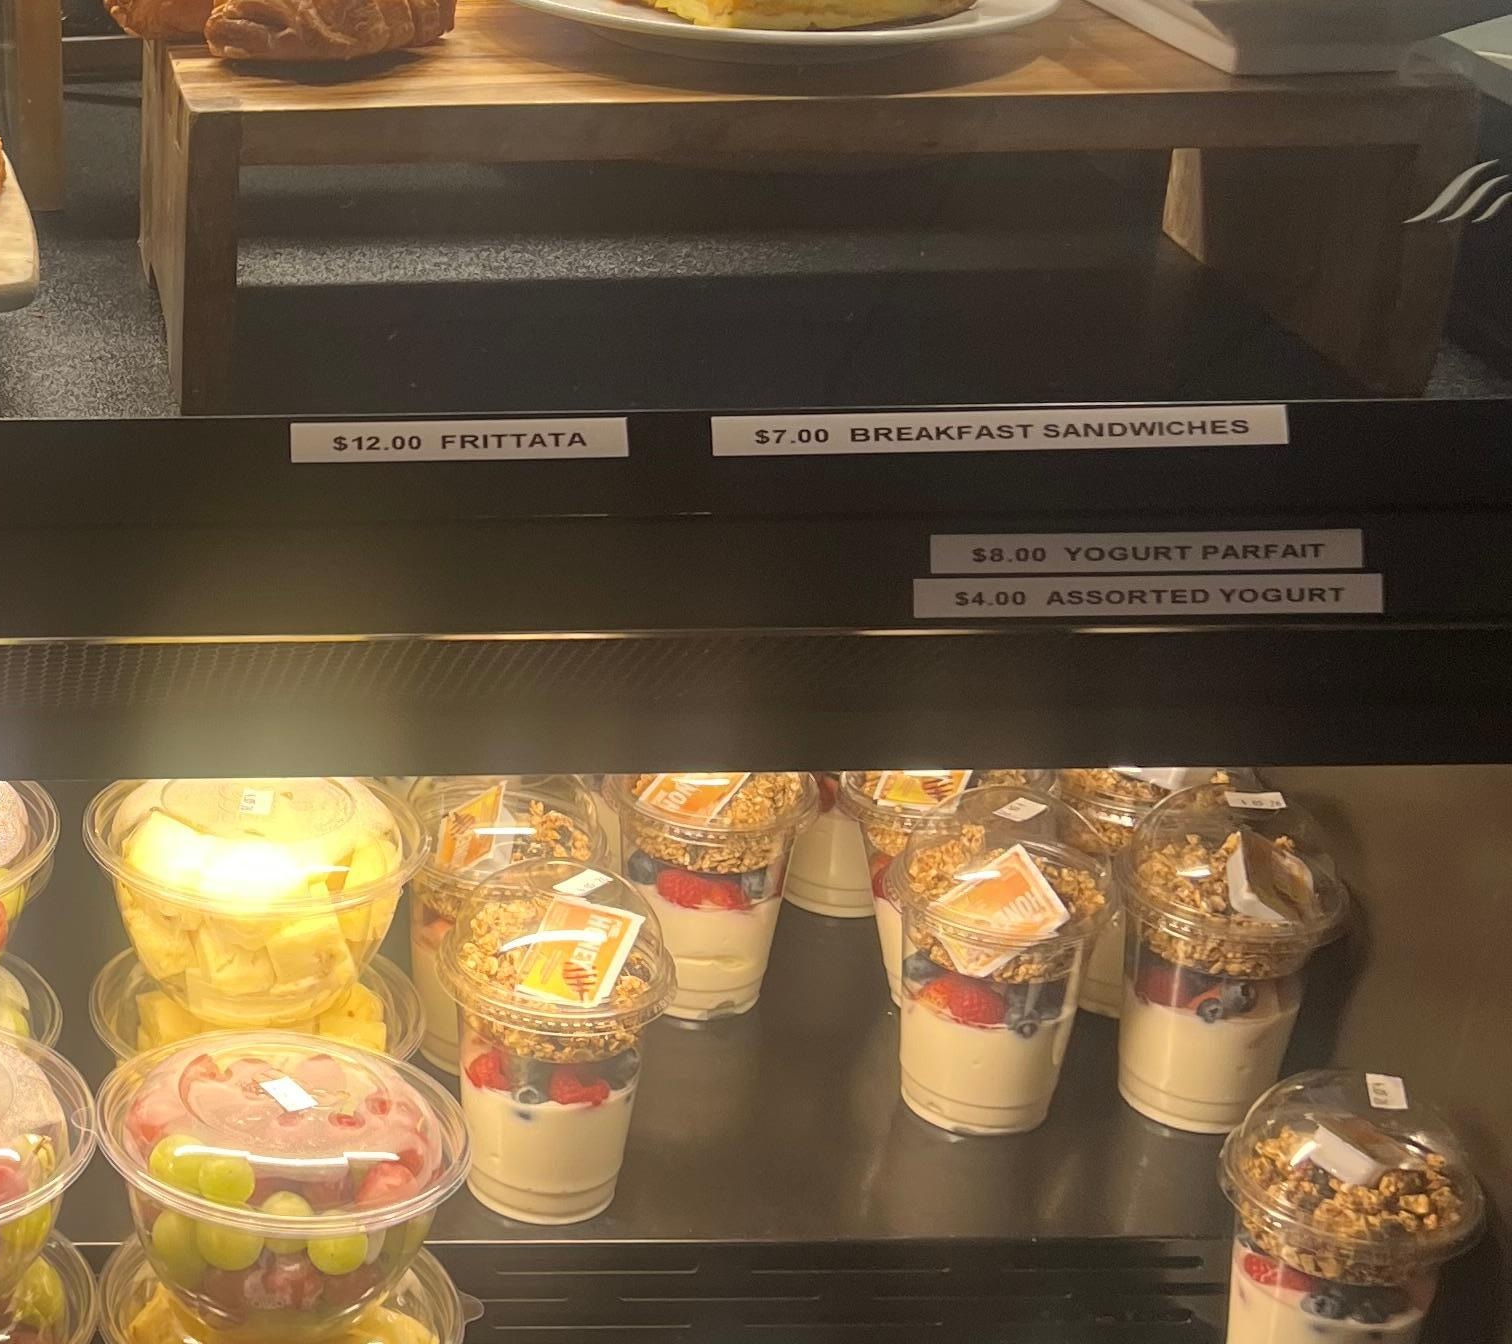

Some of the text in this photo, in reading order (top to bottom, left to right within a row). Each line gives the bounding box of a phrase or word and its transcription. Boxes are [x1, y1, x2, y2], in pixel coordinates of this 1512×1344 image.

[333, 432, 589, 452] $12.00 FRITTATA
[755, 419, 1252, 445] $7.00 BREAKFAST SANDWICHES
[972, 543, 1326, 563] $8.00 YOGURT PARFAIT
[955, 587, 1345, 607] $4.00 ASSORTED YOGURT
